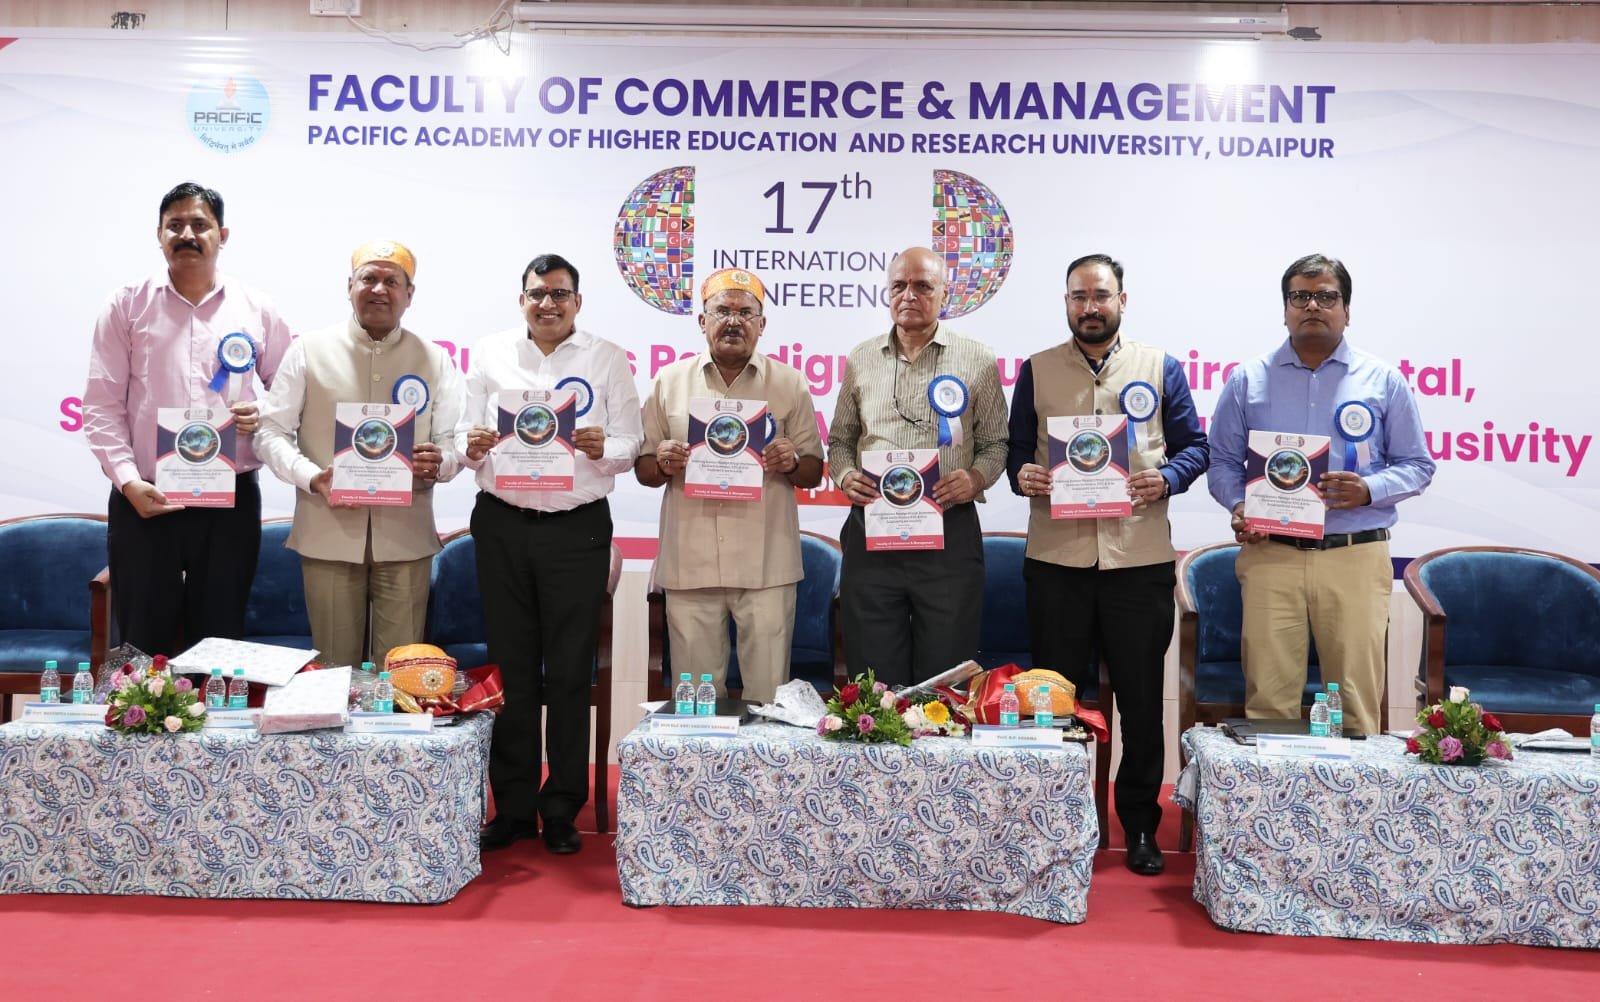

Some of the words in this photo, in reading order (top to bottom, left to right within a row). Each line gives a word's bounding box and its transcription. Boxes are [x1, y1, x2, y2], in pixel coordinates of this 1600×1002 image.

[308, 74, 527, 114] FACULTY
[538, 76, 603, 115] OF
[614, 77, 904, 120] COMMERCE
[917, 80, 956, 120] &
[968, 81, 1336, 124] MANAGEMENT
[307, 125, 408, 146] PACIFIC
[414, 126, 543, 148] ACADEMY
[549, 128, 582, 149] OF
[588, 129, 681, 150] HIGHER
[688, 130, 837, 153] EDUCATION
[849, 132, 906, 154] AND
[911, 133, 1046, 155] RESEARCH
[1052, 134, 1211, 160] UNIVERSITY,
[1218, 136, 1335, 160] UDAIPUR
[763, 171, 873, 234] 17th
[713, 249, 899, 272] INTERNATION
[1424, 420, 1593, 478] usivity
